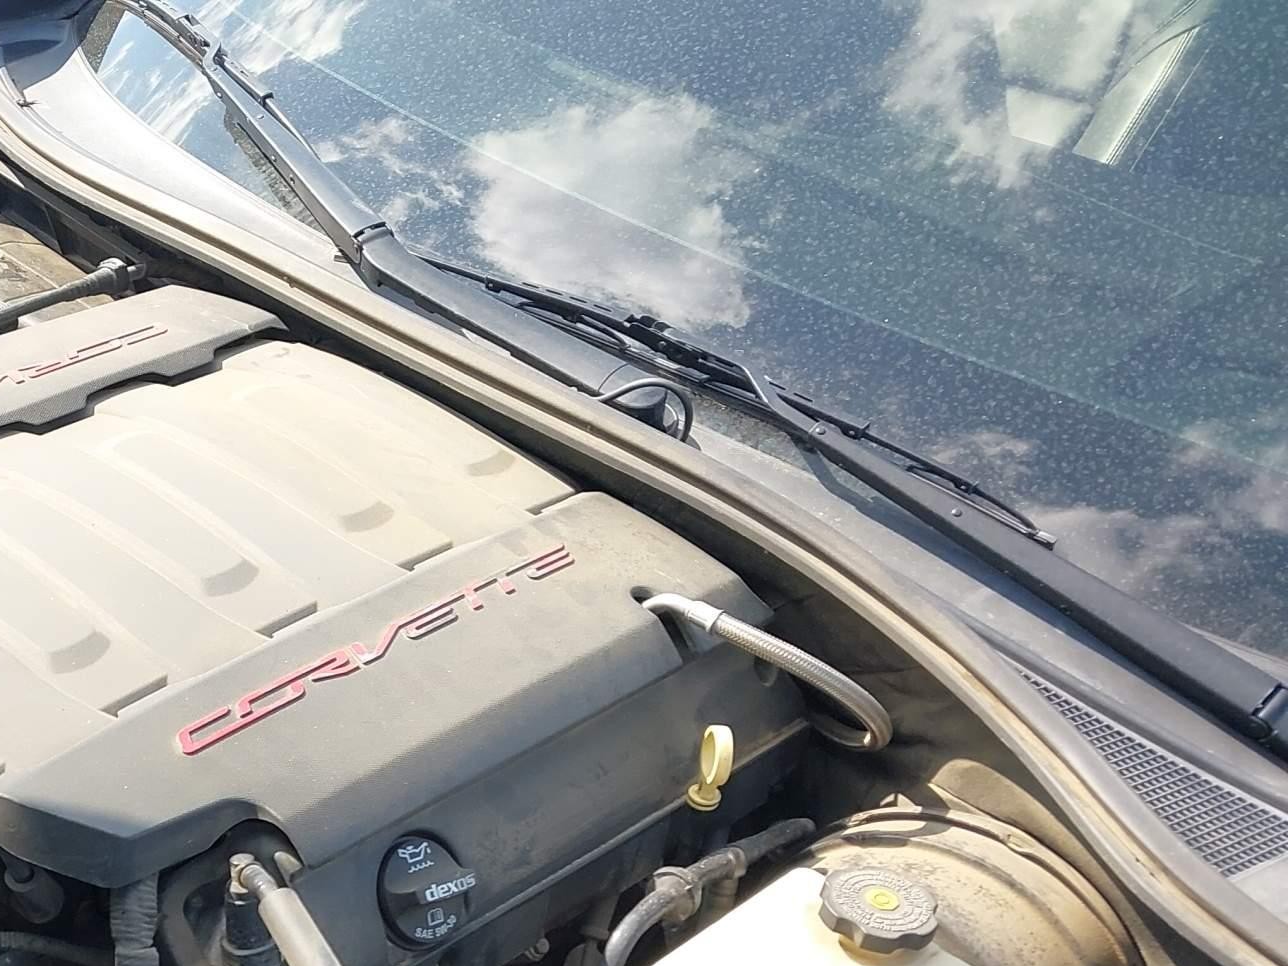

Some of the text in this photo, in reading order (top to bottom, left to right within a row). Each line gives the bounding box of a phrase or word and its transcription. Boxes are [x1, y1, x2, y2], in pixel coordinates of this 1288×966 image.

[177, 543, 575, 756] CORVETTE
[425, 873, 476, 901] dexos
[415, 915, 457, 938] SAE 5W-30
